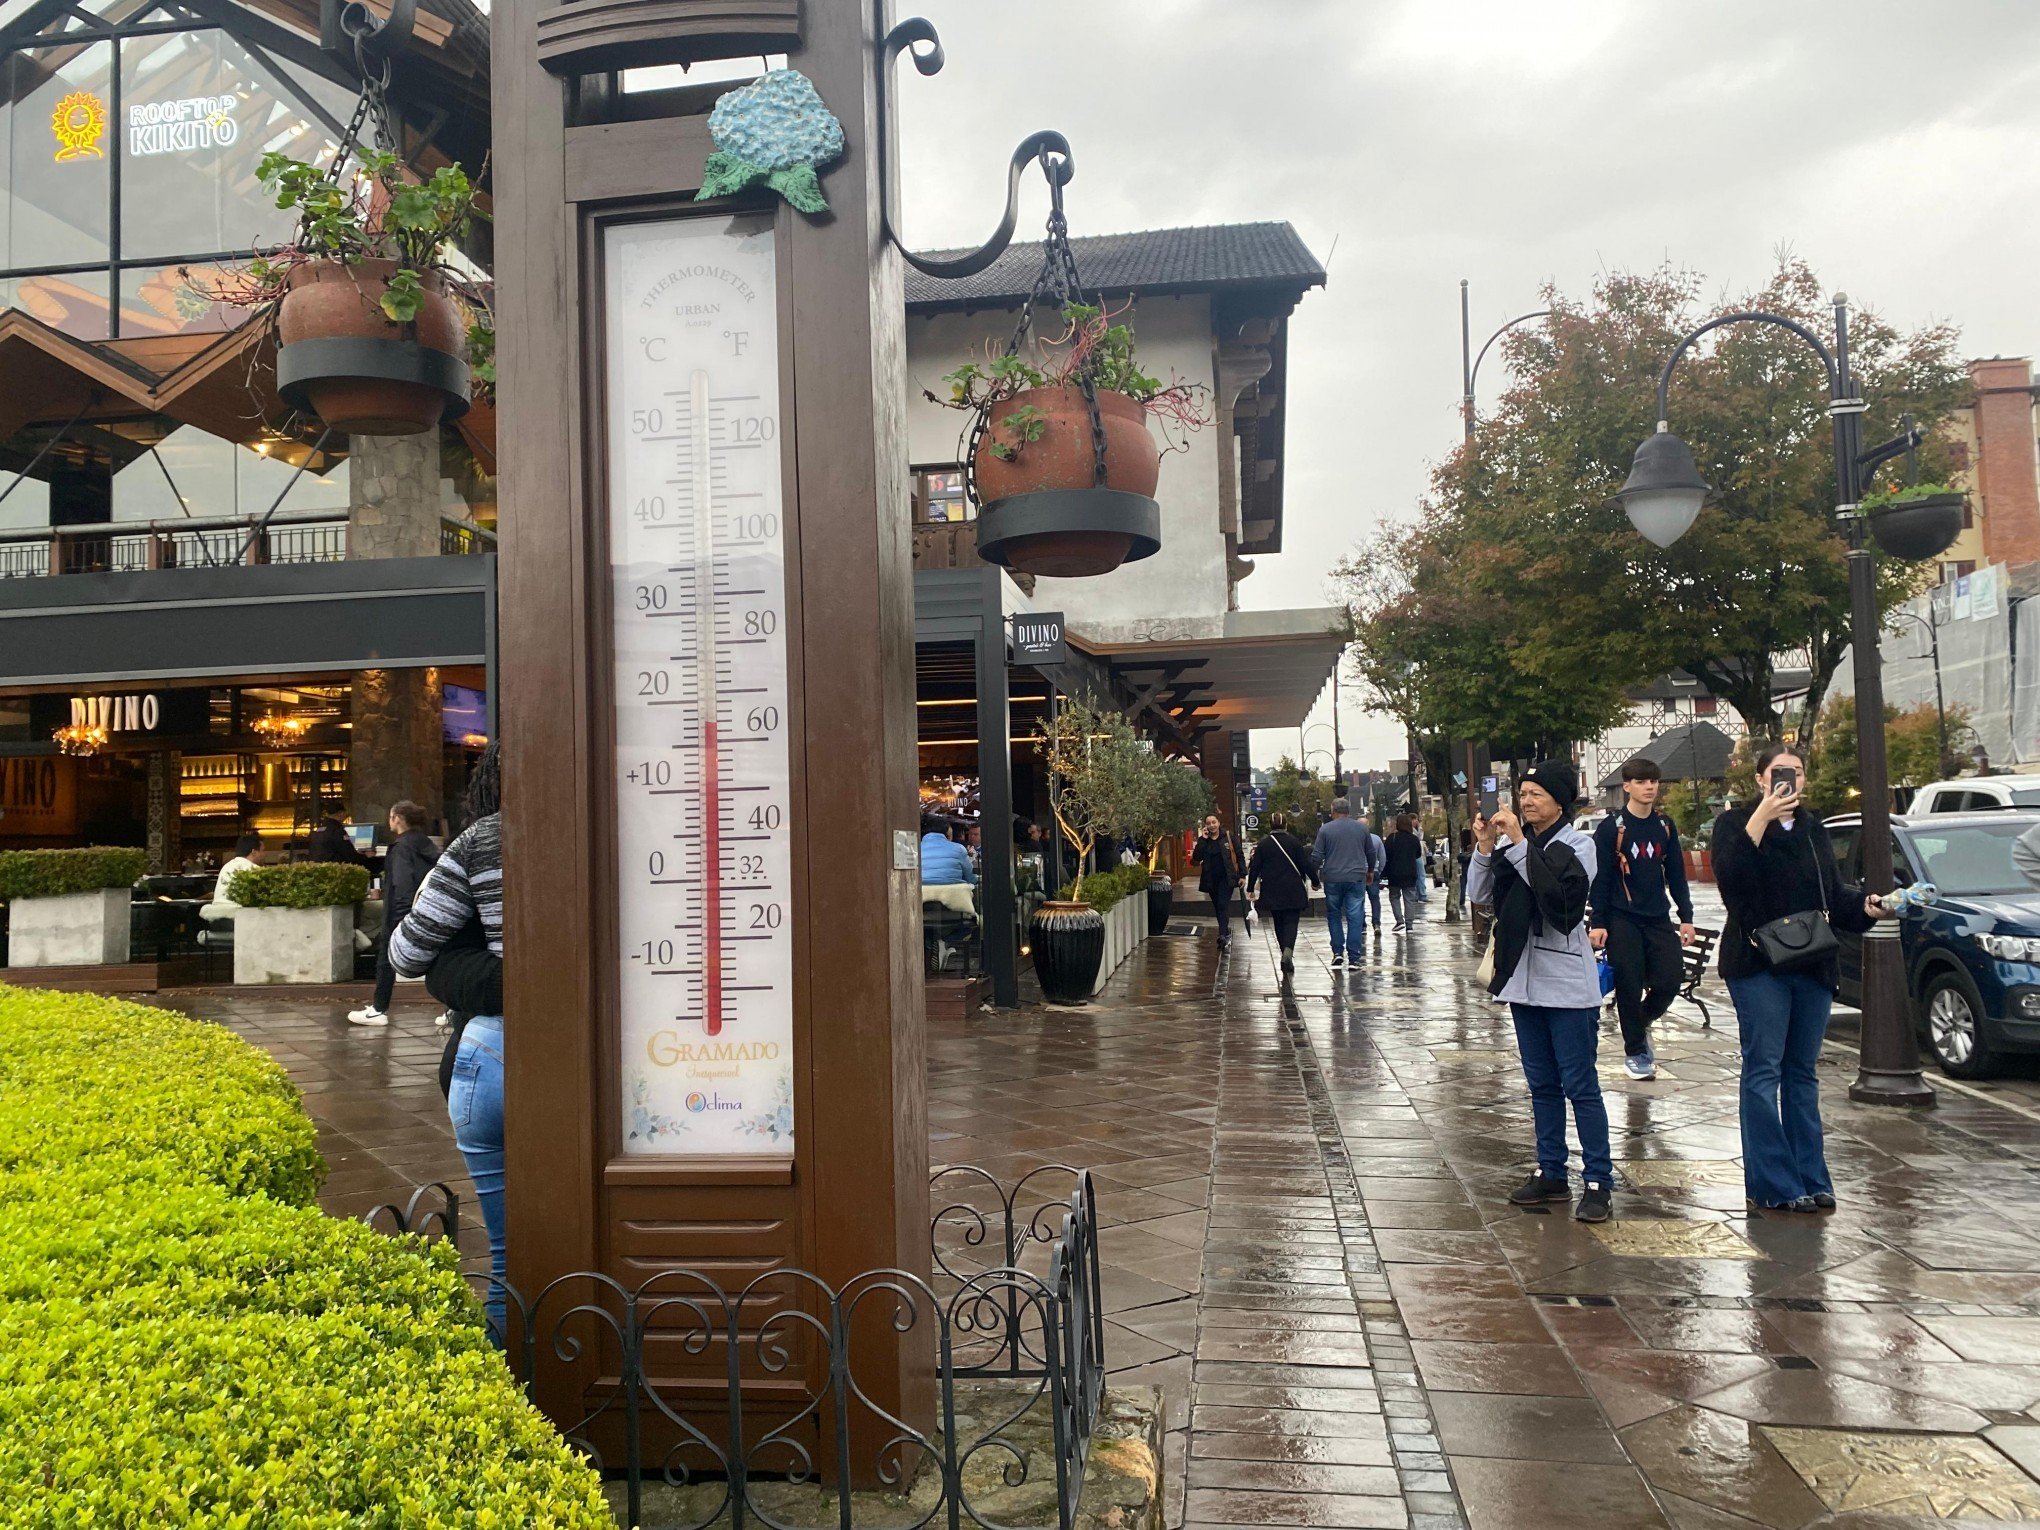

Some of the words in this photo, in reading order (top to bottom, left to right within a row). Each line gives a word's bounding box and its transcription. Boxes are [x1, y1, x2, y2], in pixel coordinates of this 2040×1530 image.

[129, 94, 237, 126] ROOFTOP
[129, 116, 238, 156] KIKITO
[641, 265, 756, 311] THERMOMETER
[675, 303, 720, 316] URBAN
[632, 408, 663, 434] 50
[731, 416, 775, 442] 120
[633, 496, 665, 521] 40
[733, 513, 778, 539] 100
[635, 584, 667, 610] 30
[744, 610, 776, 635] 80
[1019, 624, 1059, 643] DIVINO
[638, 671, 669, 695] 20
[71, 694, 159, 732] DIVINO
[747, 706, 778, 731] 60
[627, 760, 671, 786] +10
[748, 805, 781, 830] 40
[649, 851, 664, 876] 0
[740, 855, 764, 874] 32
[750, 903, 782, 929] 20
[631, 940, 673, 966] -10
[647, 1030, 779, 1067] GRAMADO
